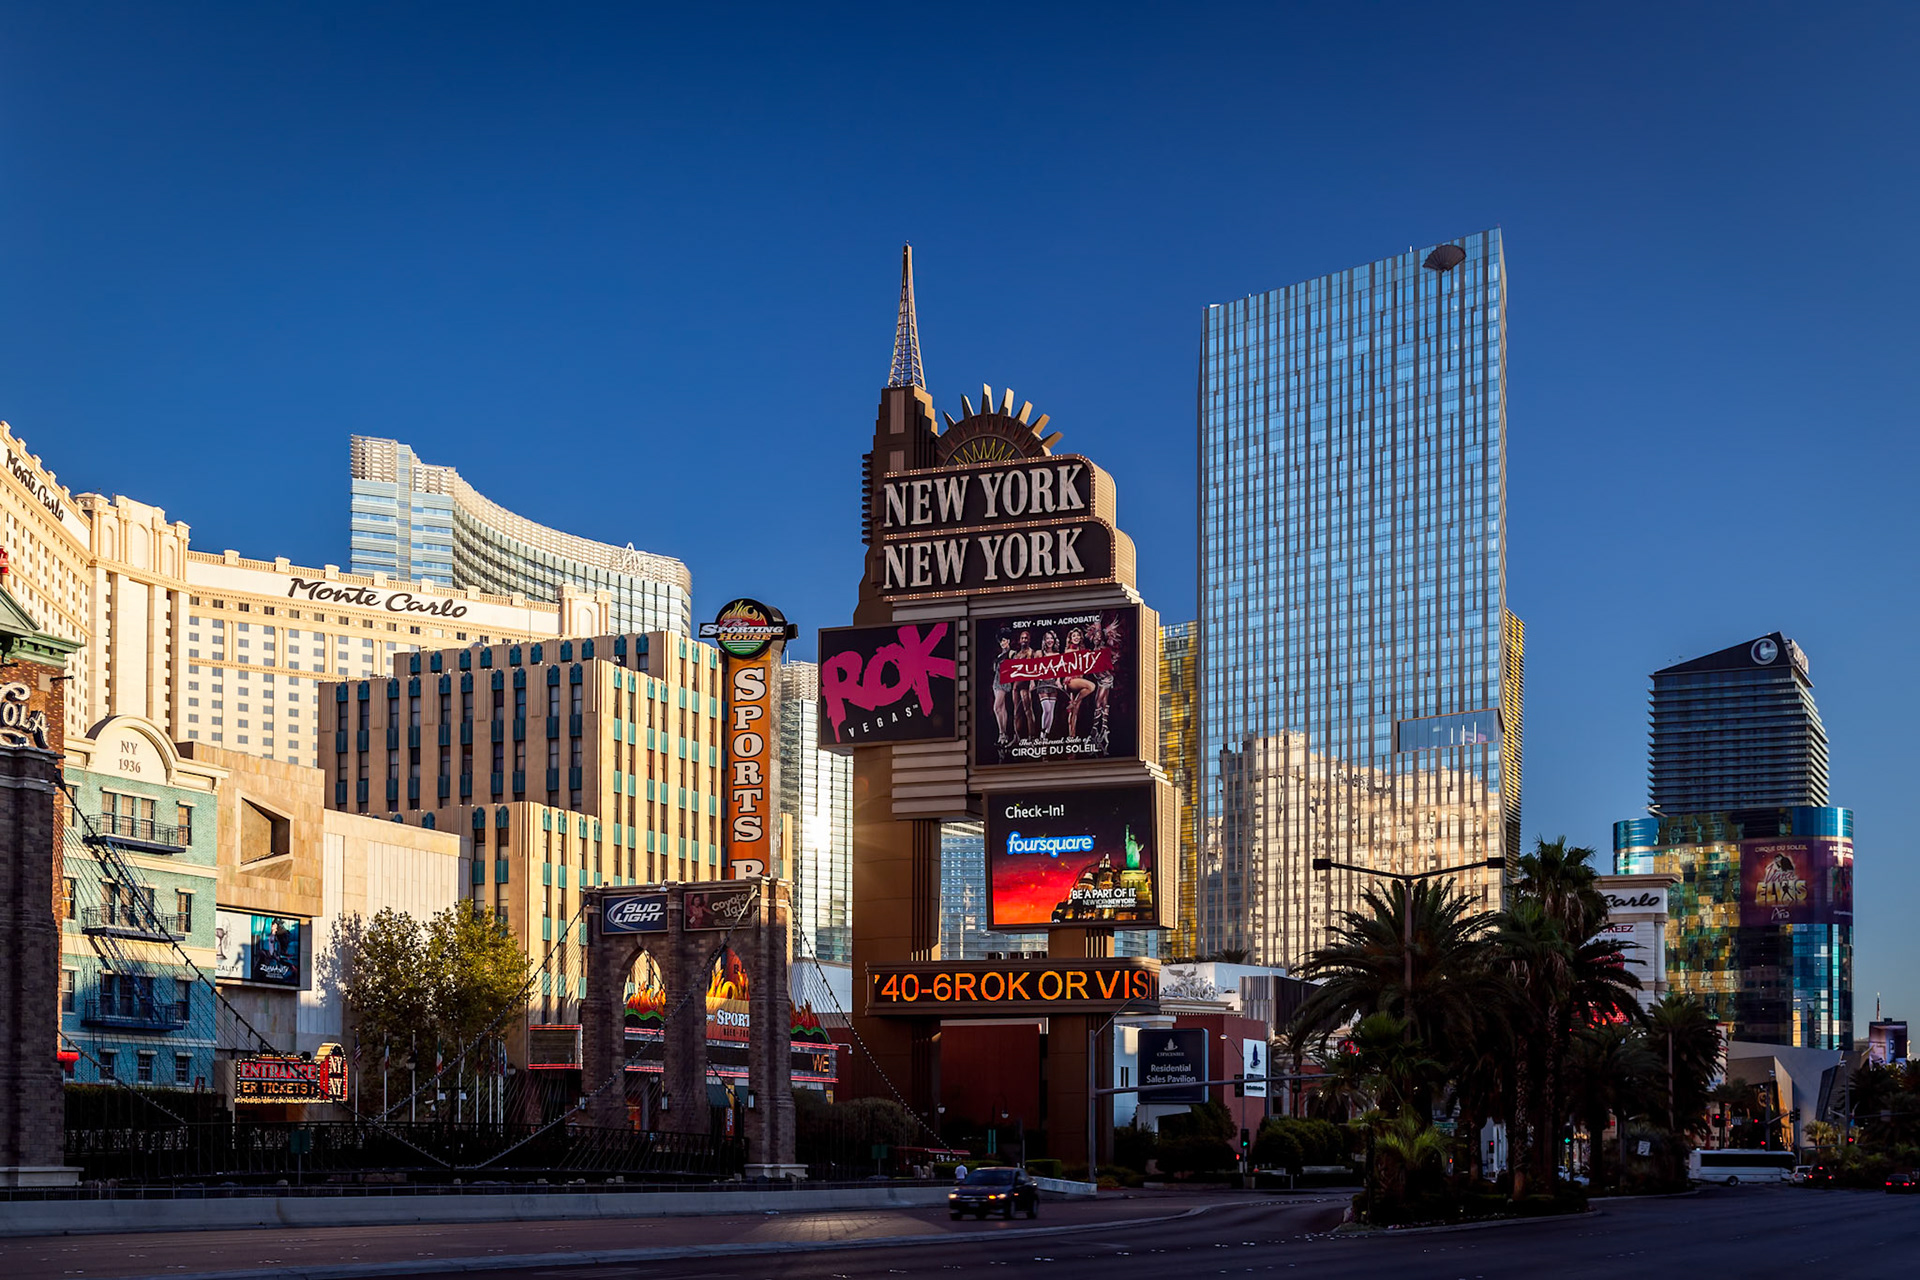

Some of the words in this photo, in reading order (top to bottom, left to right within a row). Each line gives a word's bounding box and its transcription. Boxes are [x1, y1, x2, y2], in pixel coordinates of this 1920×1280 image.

[6, 448, 37, 495] Monte
[37, 485, 64, 522] Carlo
[883, 475, 970, 528] NEW
[978, 464, 1085, 518] YORK
[883, 538, 970, 590] NEW
[978, 527, 1085, 581] YORK
[288, 577, 381, 607] Monte
[385, 593, 467, 619] Carlo
[1012, 620, 1032, 629] SEXY
[1036, 618, 1053, 627] FUN
[1057, 614, 1100, 626] ACROBATIC
[1009, 651, 1102, 678] ZUMANITY
[821, 622, 956, 743] ROK
[120, 740, 138, 755] NY
[1018, 738, 1033, 747] The
[1065, 735, 1081, 744] Side
[1082, 735, 1092, 745] of
[732, 666, 767, 842] SPORTS
[1011, 747, 1047, 758] CIRQUE
[1049, 745, 1063, 755] DU
[1065, 743, 1099, 754] SOLEIL
[118, 758, 141, 773] 1936
[1005, 804, 1065, 819] Check-In!
[1008, 833, 1093, 856] foursquare
[1072, 889, 1083, 899] BE
[1092, 888, 1112, 898] PART
[1113, 887, 1127, 897] OF
[614, 911, 664, 923] LIGHT
[622, 903, 662, 914] BUD
[1038, 970, 1090, 1001] OR
[241, 1062, 316, 1080] ENTRANCE
[328, 1055, 343, 1074] NY
[812, 1053, 829, 1073] WE
[1150, 1063, 1192, 1072] Residential
[328, 1077, 343, 1096] NY
[1146, 1074, 1165, 1084] Sales
[1167, 1073, 1197, 1083] Pavilion
[261, 1082, 309, 1095] TICKETS
